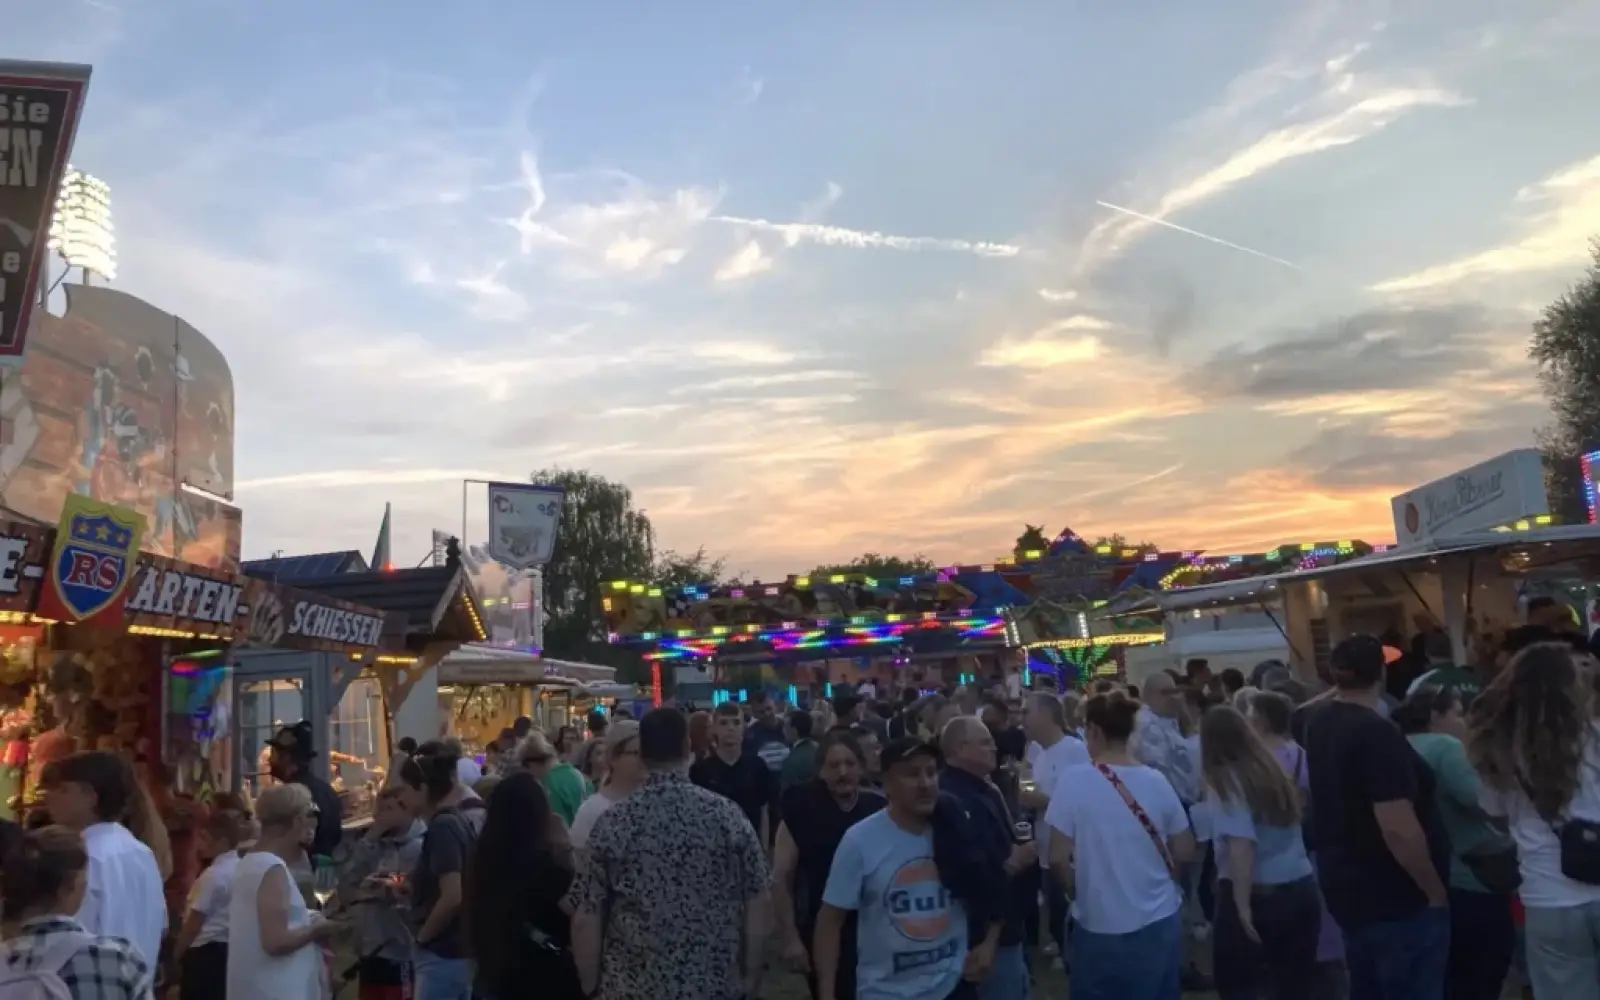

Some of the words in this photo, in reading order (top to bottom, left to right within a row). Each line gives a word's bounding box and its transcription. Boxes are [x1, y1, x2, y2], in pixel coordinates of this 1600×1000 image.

[62, 549, 122, 592] RS
[124, 564, 249, 623] ARTEN-
[287, 601, 384, 646] SCHIESSEN
[889, 886, 951, 914] Gul
